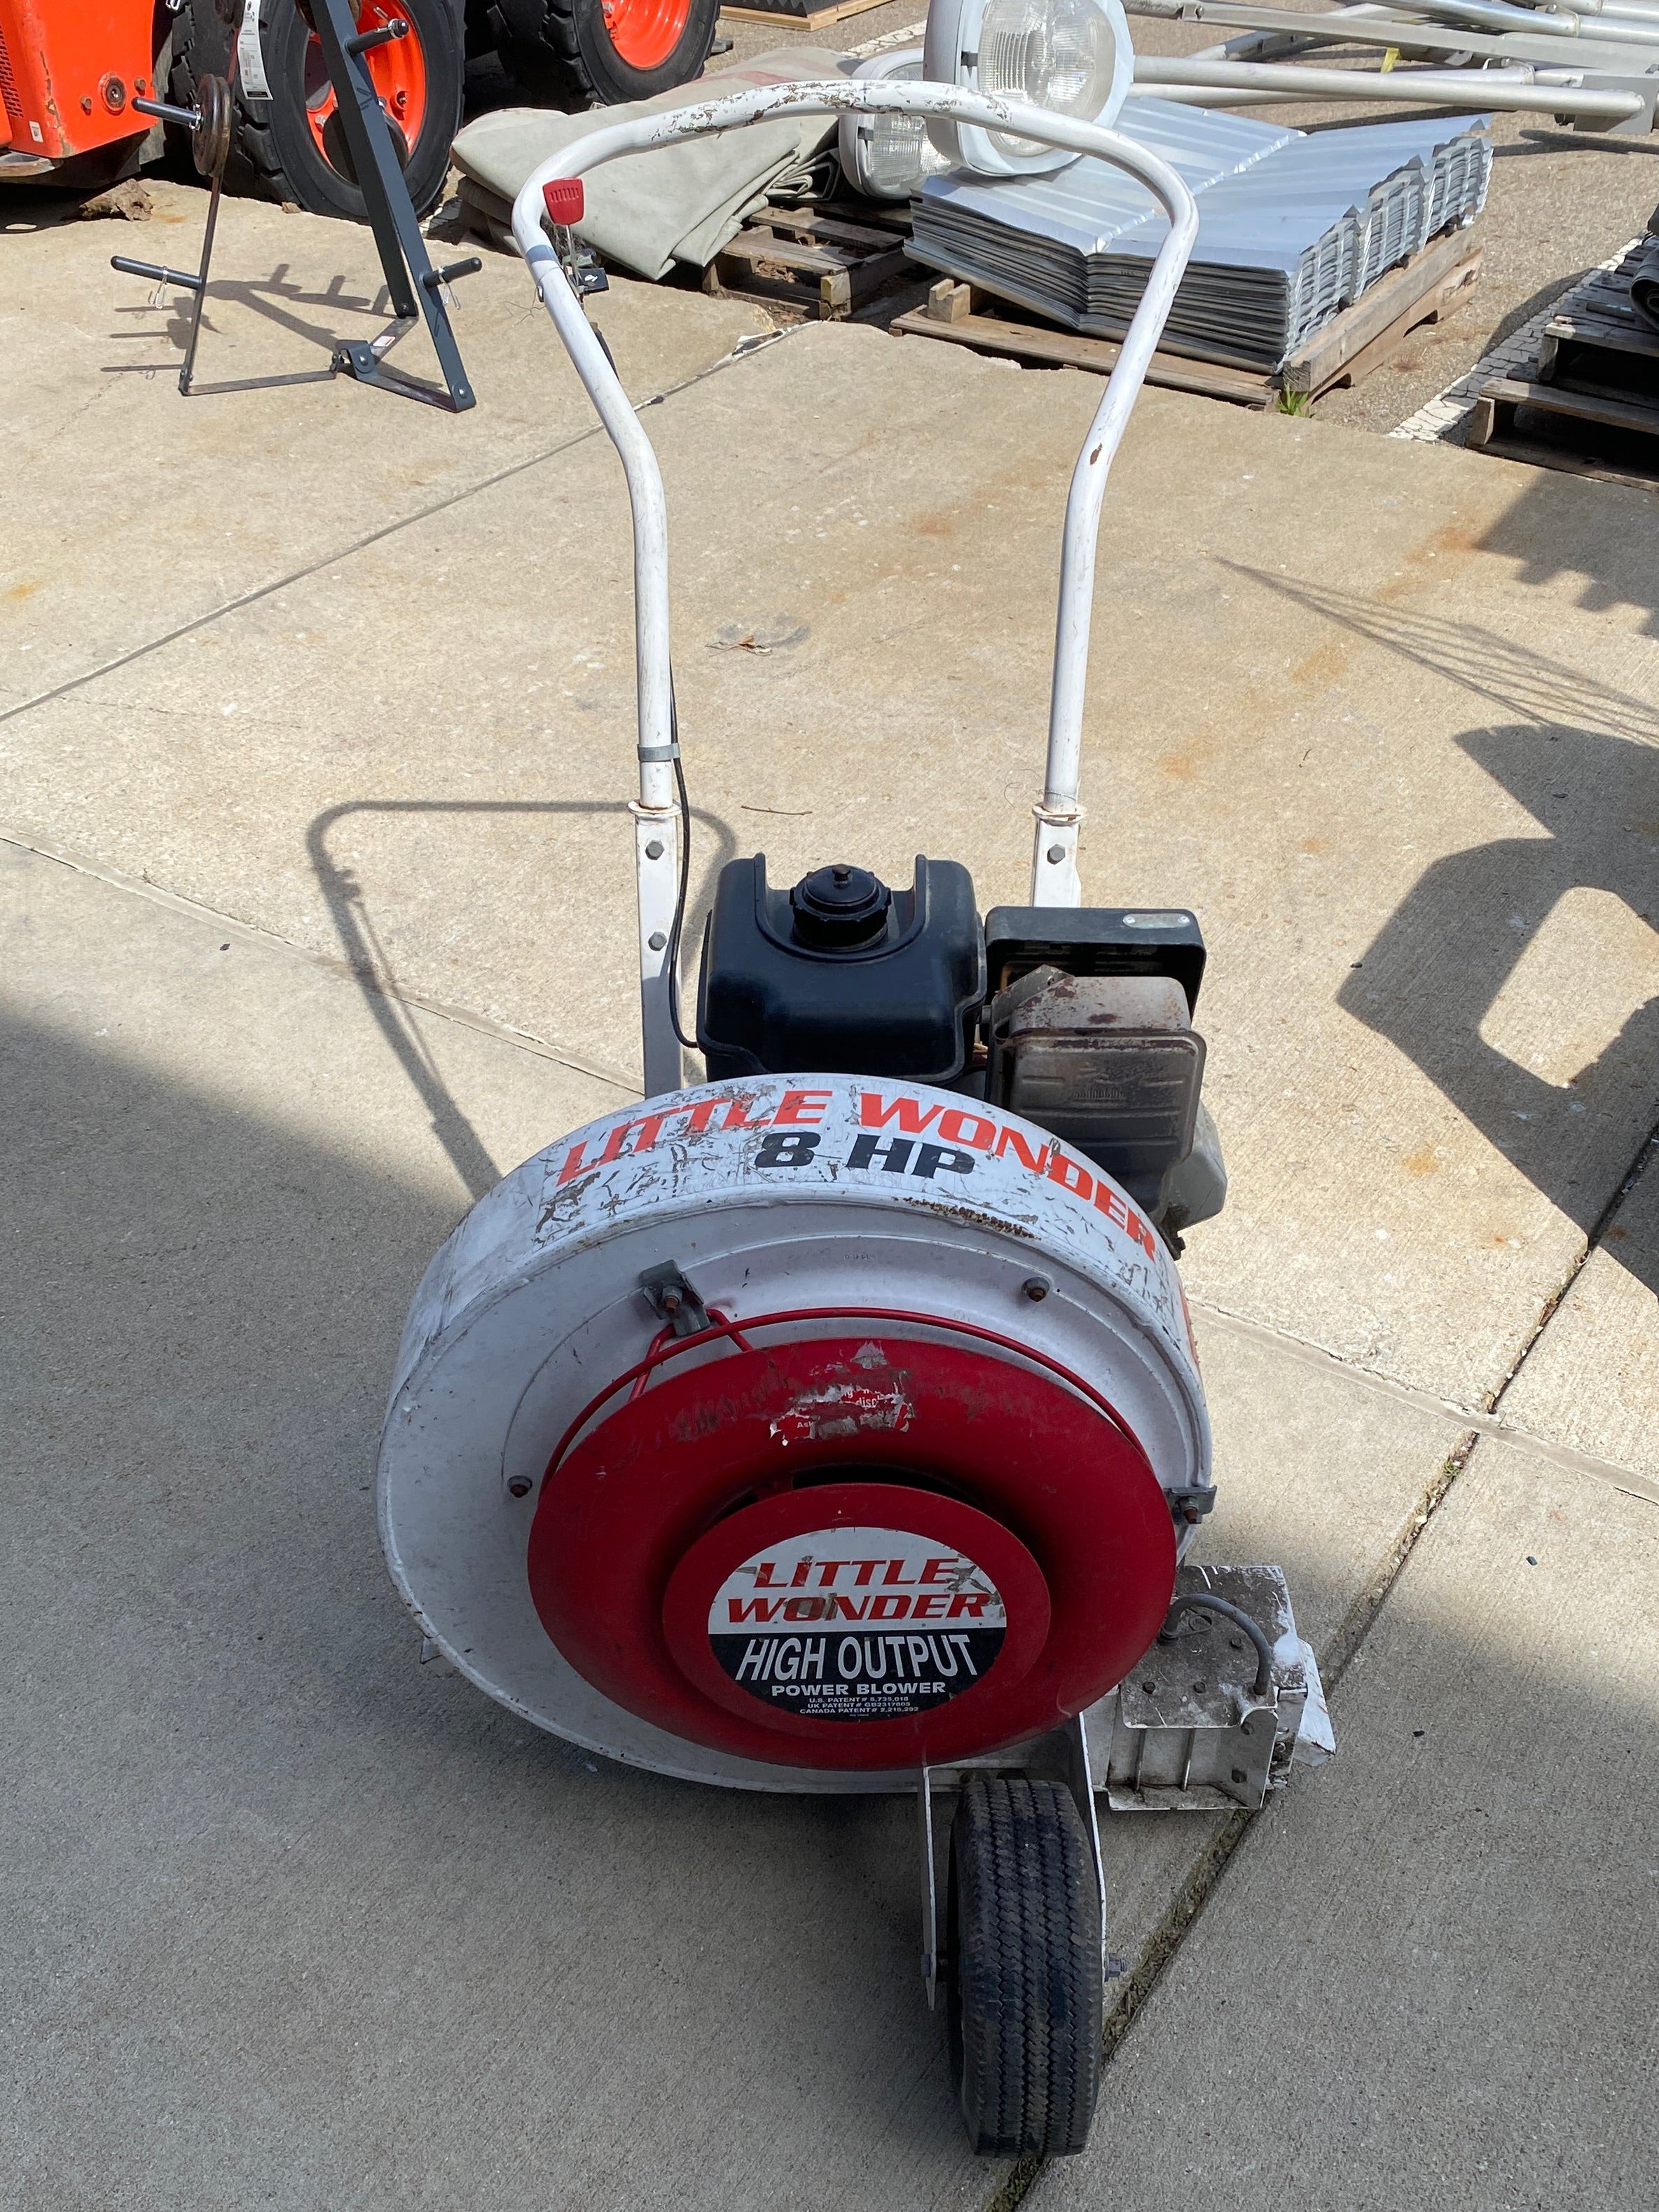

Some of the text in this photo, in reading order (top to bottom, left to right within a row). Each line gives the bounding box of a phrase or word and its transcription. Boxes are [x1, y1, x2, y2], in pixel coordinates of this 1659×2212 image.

[755, 1132, 975, 1179] 8 HP
[556, 1090, 1156, 1263] LITTLE WONDER
[753, 1558, 959, 1588] LITTLE
[728, 1593, 991, 1623] WONDER
[735, 1634, 978, 1681] HIGH OUTPUT
[771, 1682, 946, 1696] POWER BLOWER
